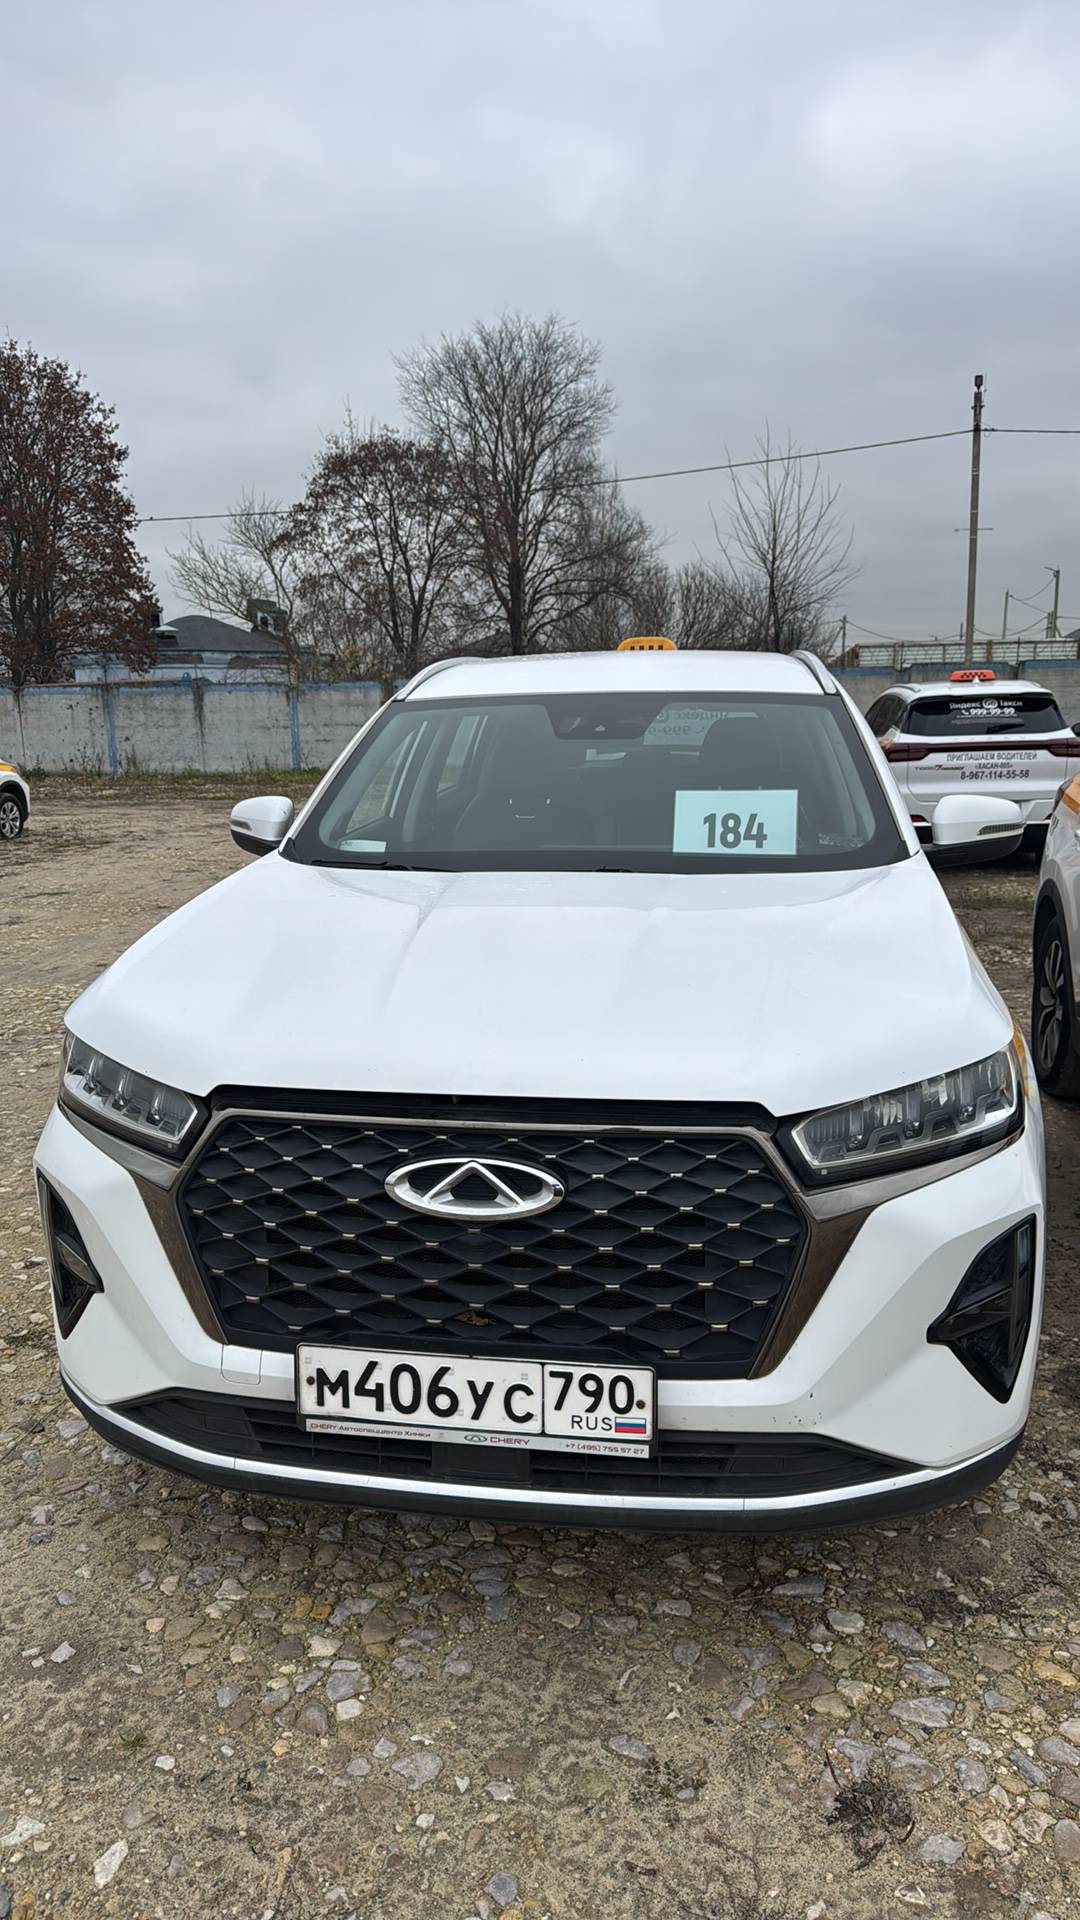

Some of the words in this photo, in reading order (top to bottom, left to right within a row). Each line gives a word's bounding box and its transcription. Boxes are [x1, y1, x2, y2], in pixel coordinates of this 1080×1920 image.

[946, 753, 995, 762] ПРИГЛАШАЕМ
[996, 751, 1038, 761] ВОДИТЕЛЕЙ
[960, 769, 1030, 780] 8-967-114-55-58
[703, 812, 768, 849] 184
[316, 1360, 535, 1423] М406УС
[549, 1371, 635, 1415] 790
[571, 1415, 613, 1431] RUS
[310, 1422, 338, 1431] CHERY
[403, 1430, 432, 1438] Химки
[489, 1436, 530, 1446] CHERY
[576, 1443, 600, 1452] (495)
[602, 1445, 619, 1453] 755
